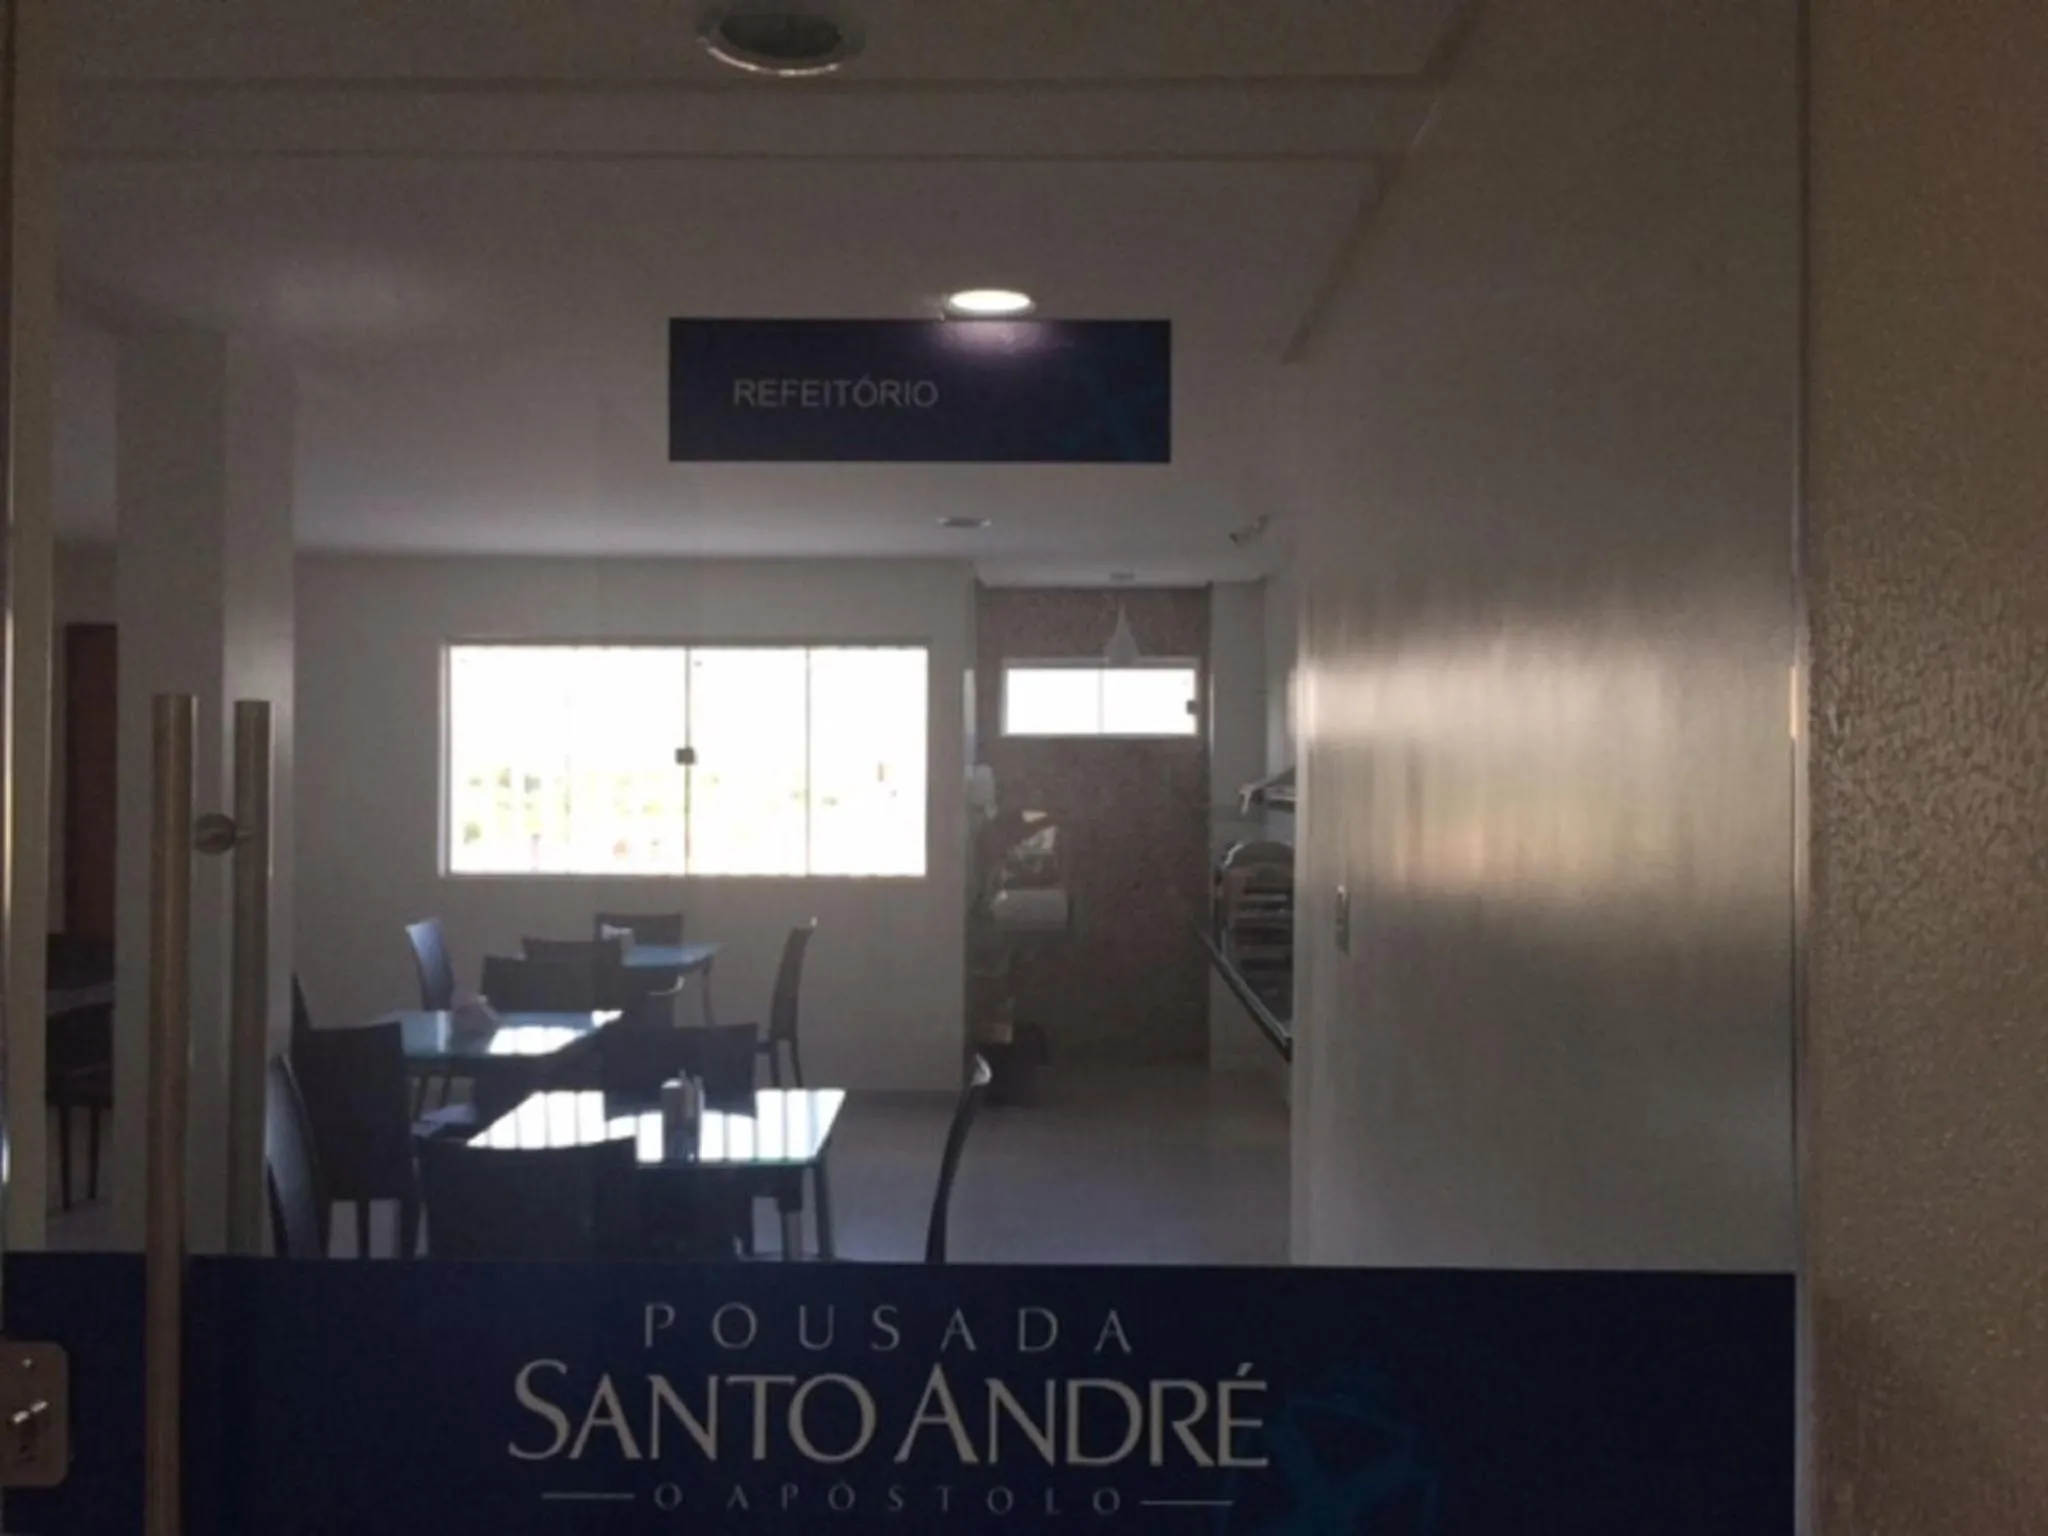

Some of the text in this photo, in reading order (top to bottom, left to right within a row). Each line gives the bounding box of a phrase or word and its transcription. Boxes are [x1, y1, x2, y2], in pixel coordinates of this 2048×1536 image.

[733, 372, 940, 408] REFEITÓRIO
[643, 1302, 1134, 1354] POUSADA
[508, 1358, 1269, 1469] SANTO ANDRÉ
[654, 1482, 685, 1511] O
